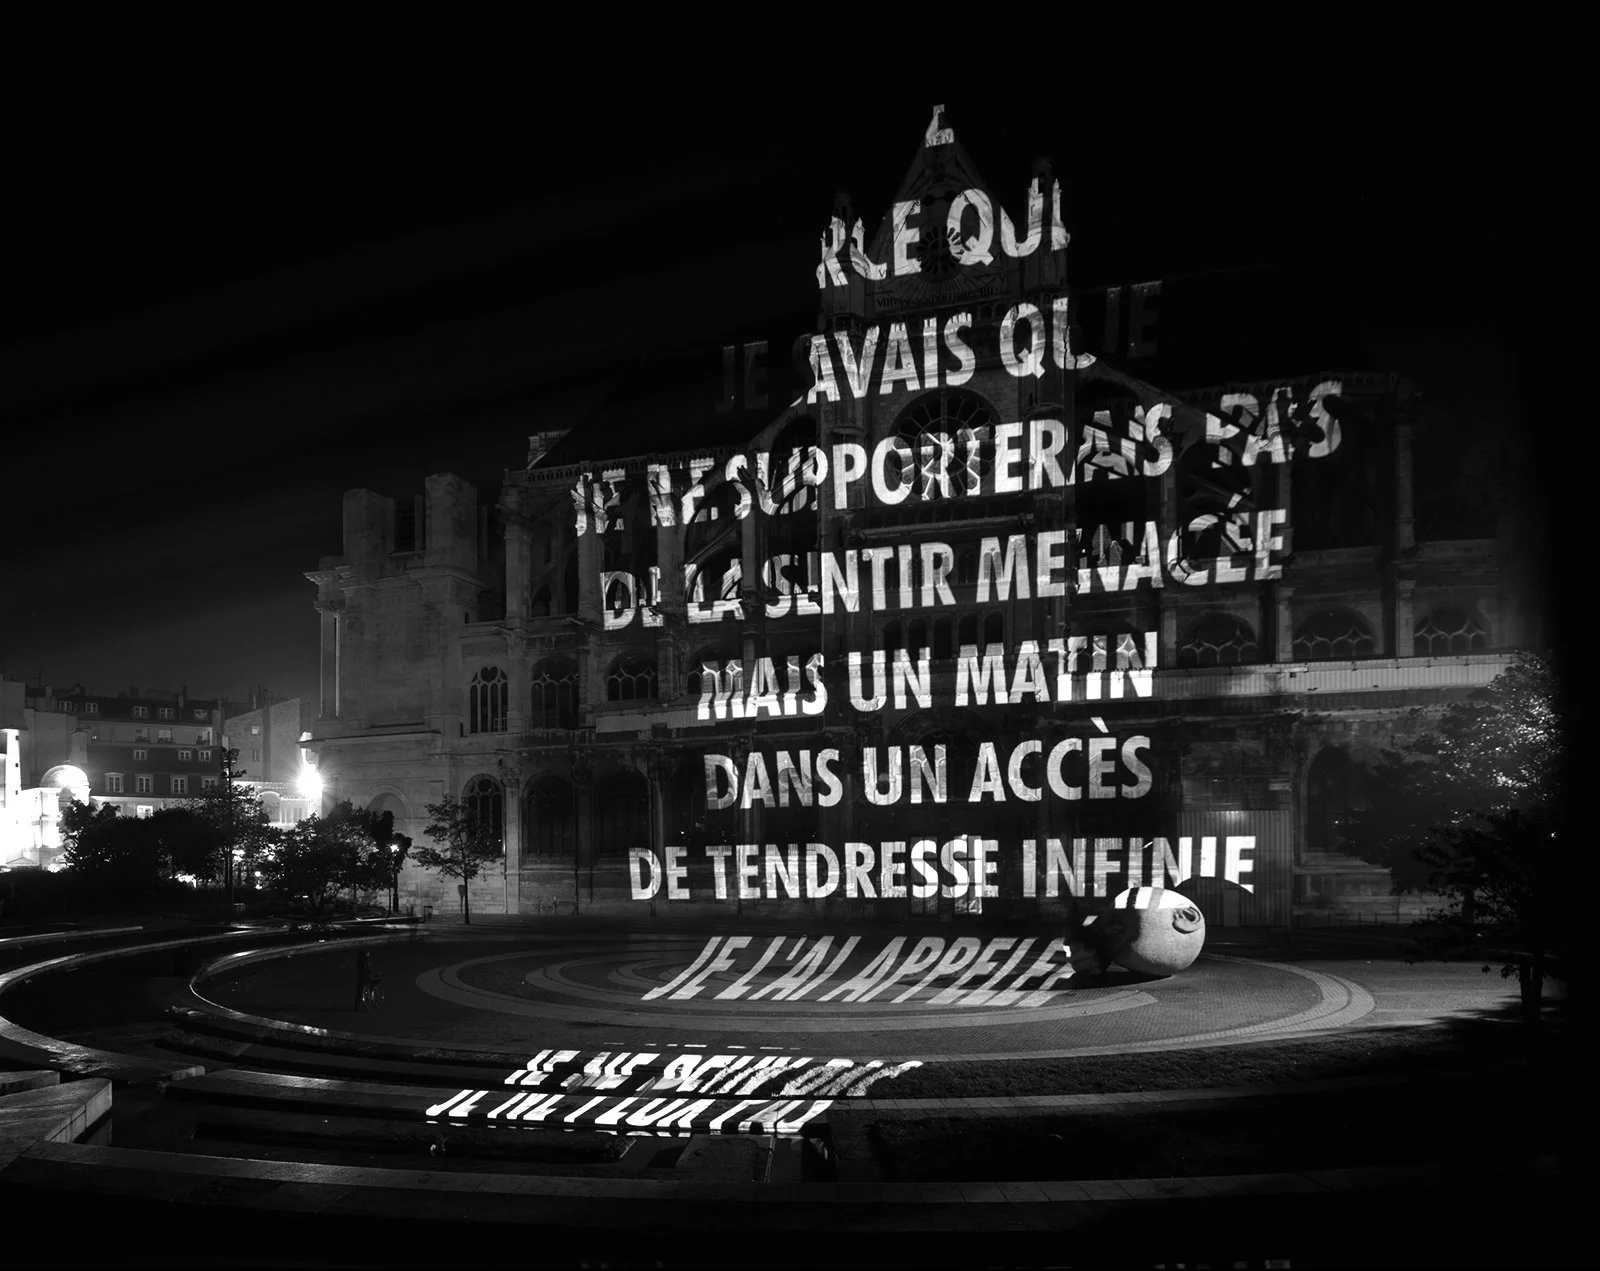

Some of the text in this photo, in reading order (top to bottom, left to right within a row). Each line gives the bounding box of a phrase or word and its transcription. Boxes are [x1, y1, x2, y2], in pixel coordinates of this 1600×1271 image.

[697, 631, 1158, 720] MAIS UN MATIN
[703, 717, 1153, 810] DANS UN ACCÈS
[629, 836, 1257, 907] DE TENDRESSE INFINIE
[639, 936, 753, 1000] JE
[713, 935, 862, 1001] L'AI
